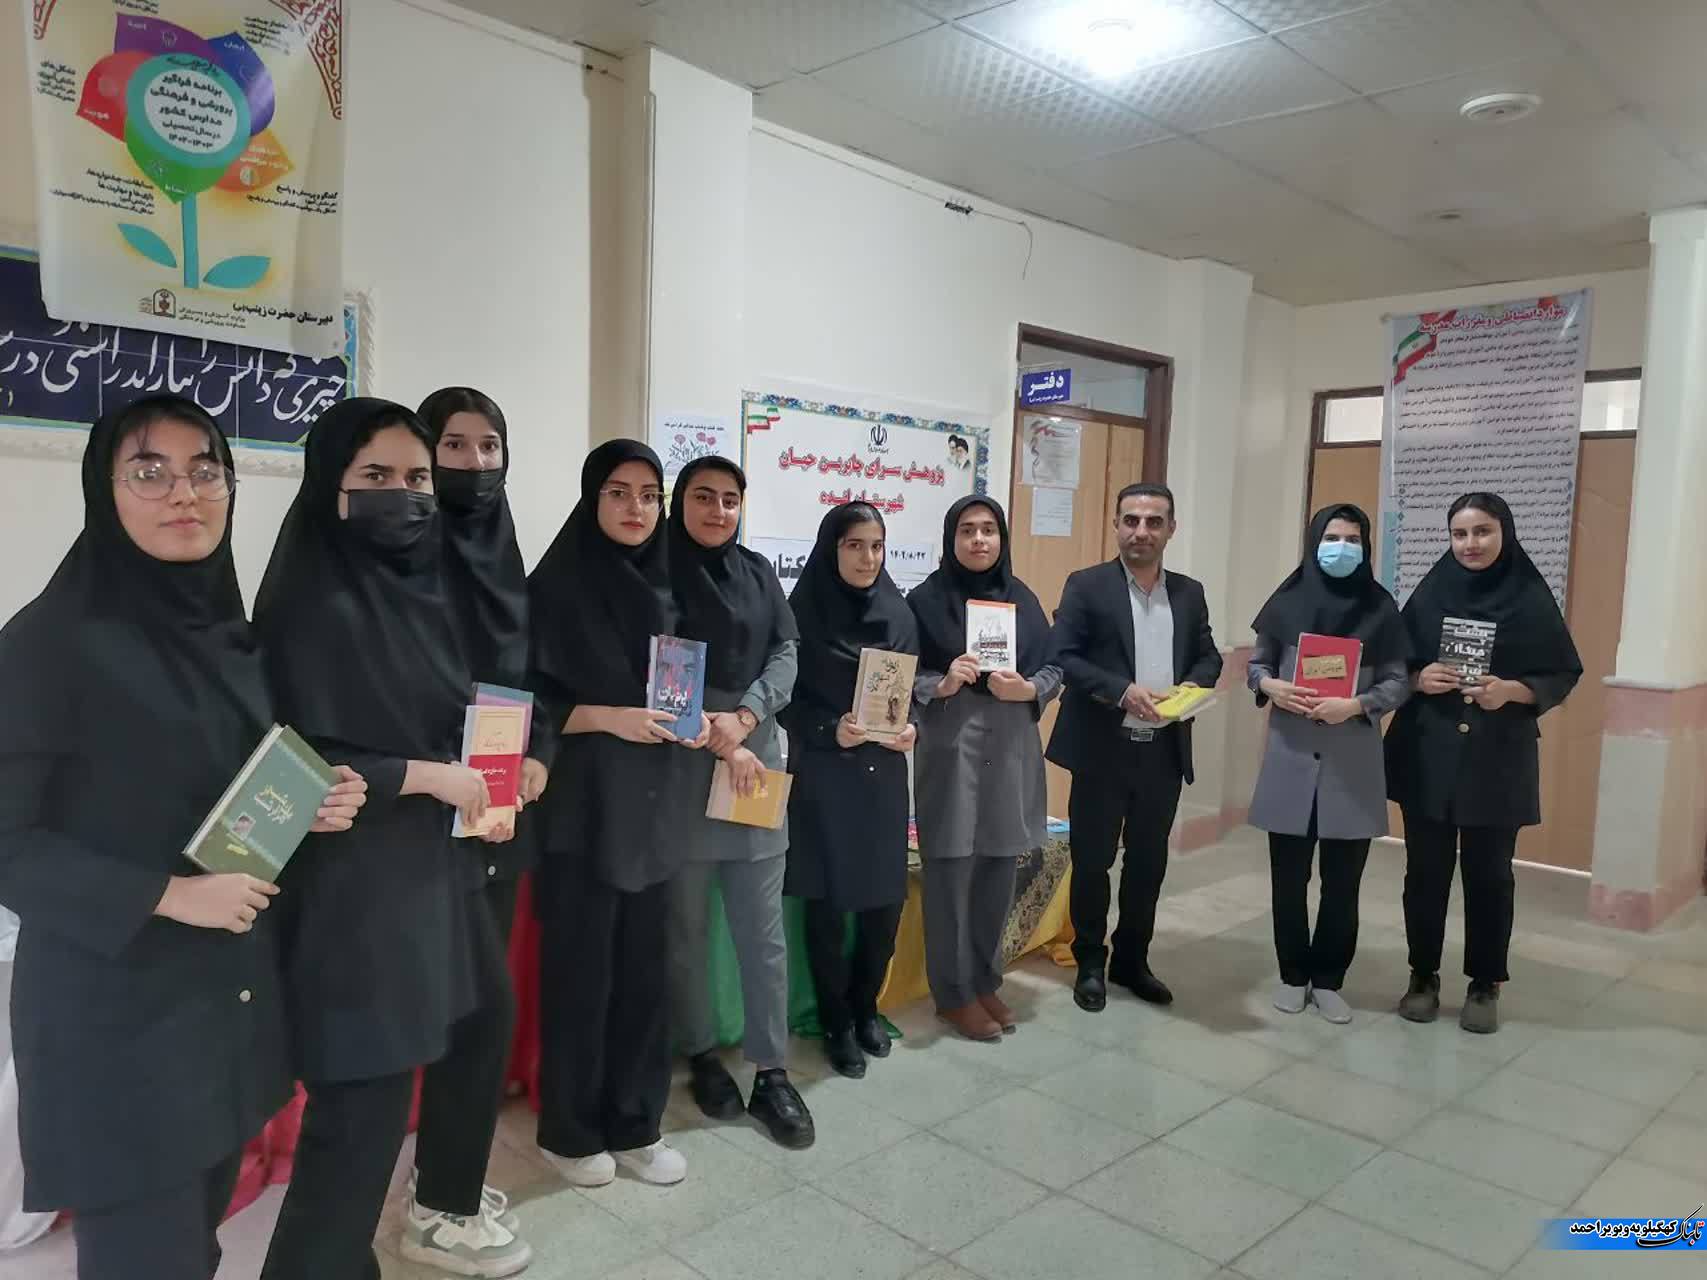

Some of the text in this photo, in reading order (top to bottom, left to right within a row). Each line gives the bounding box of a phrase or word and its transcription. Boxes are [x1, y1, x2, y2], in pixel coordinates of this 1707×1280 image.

[162, 73, 222, 98] برنامه فراگیر
[150, 86, 233, 117] پرورشی و فرهنگی
[159, 106, 222, 126] مدارس کشور
[268, 308, 296, 319] حضرت
[296, 311, 334, 326] دبیرستان
[1027, 371, 1065, 397] دفتر
[778, 447, 818, 471] حیان
[863, 457, 902, 480] سرای
[902, 461, 945, 487] پژوهش
